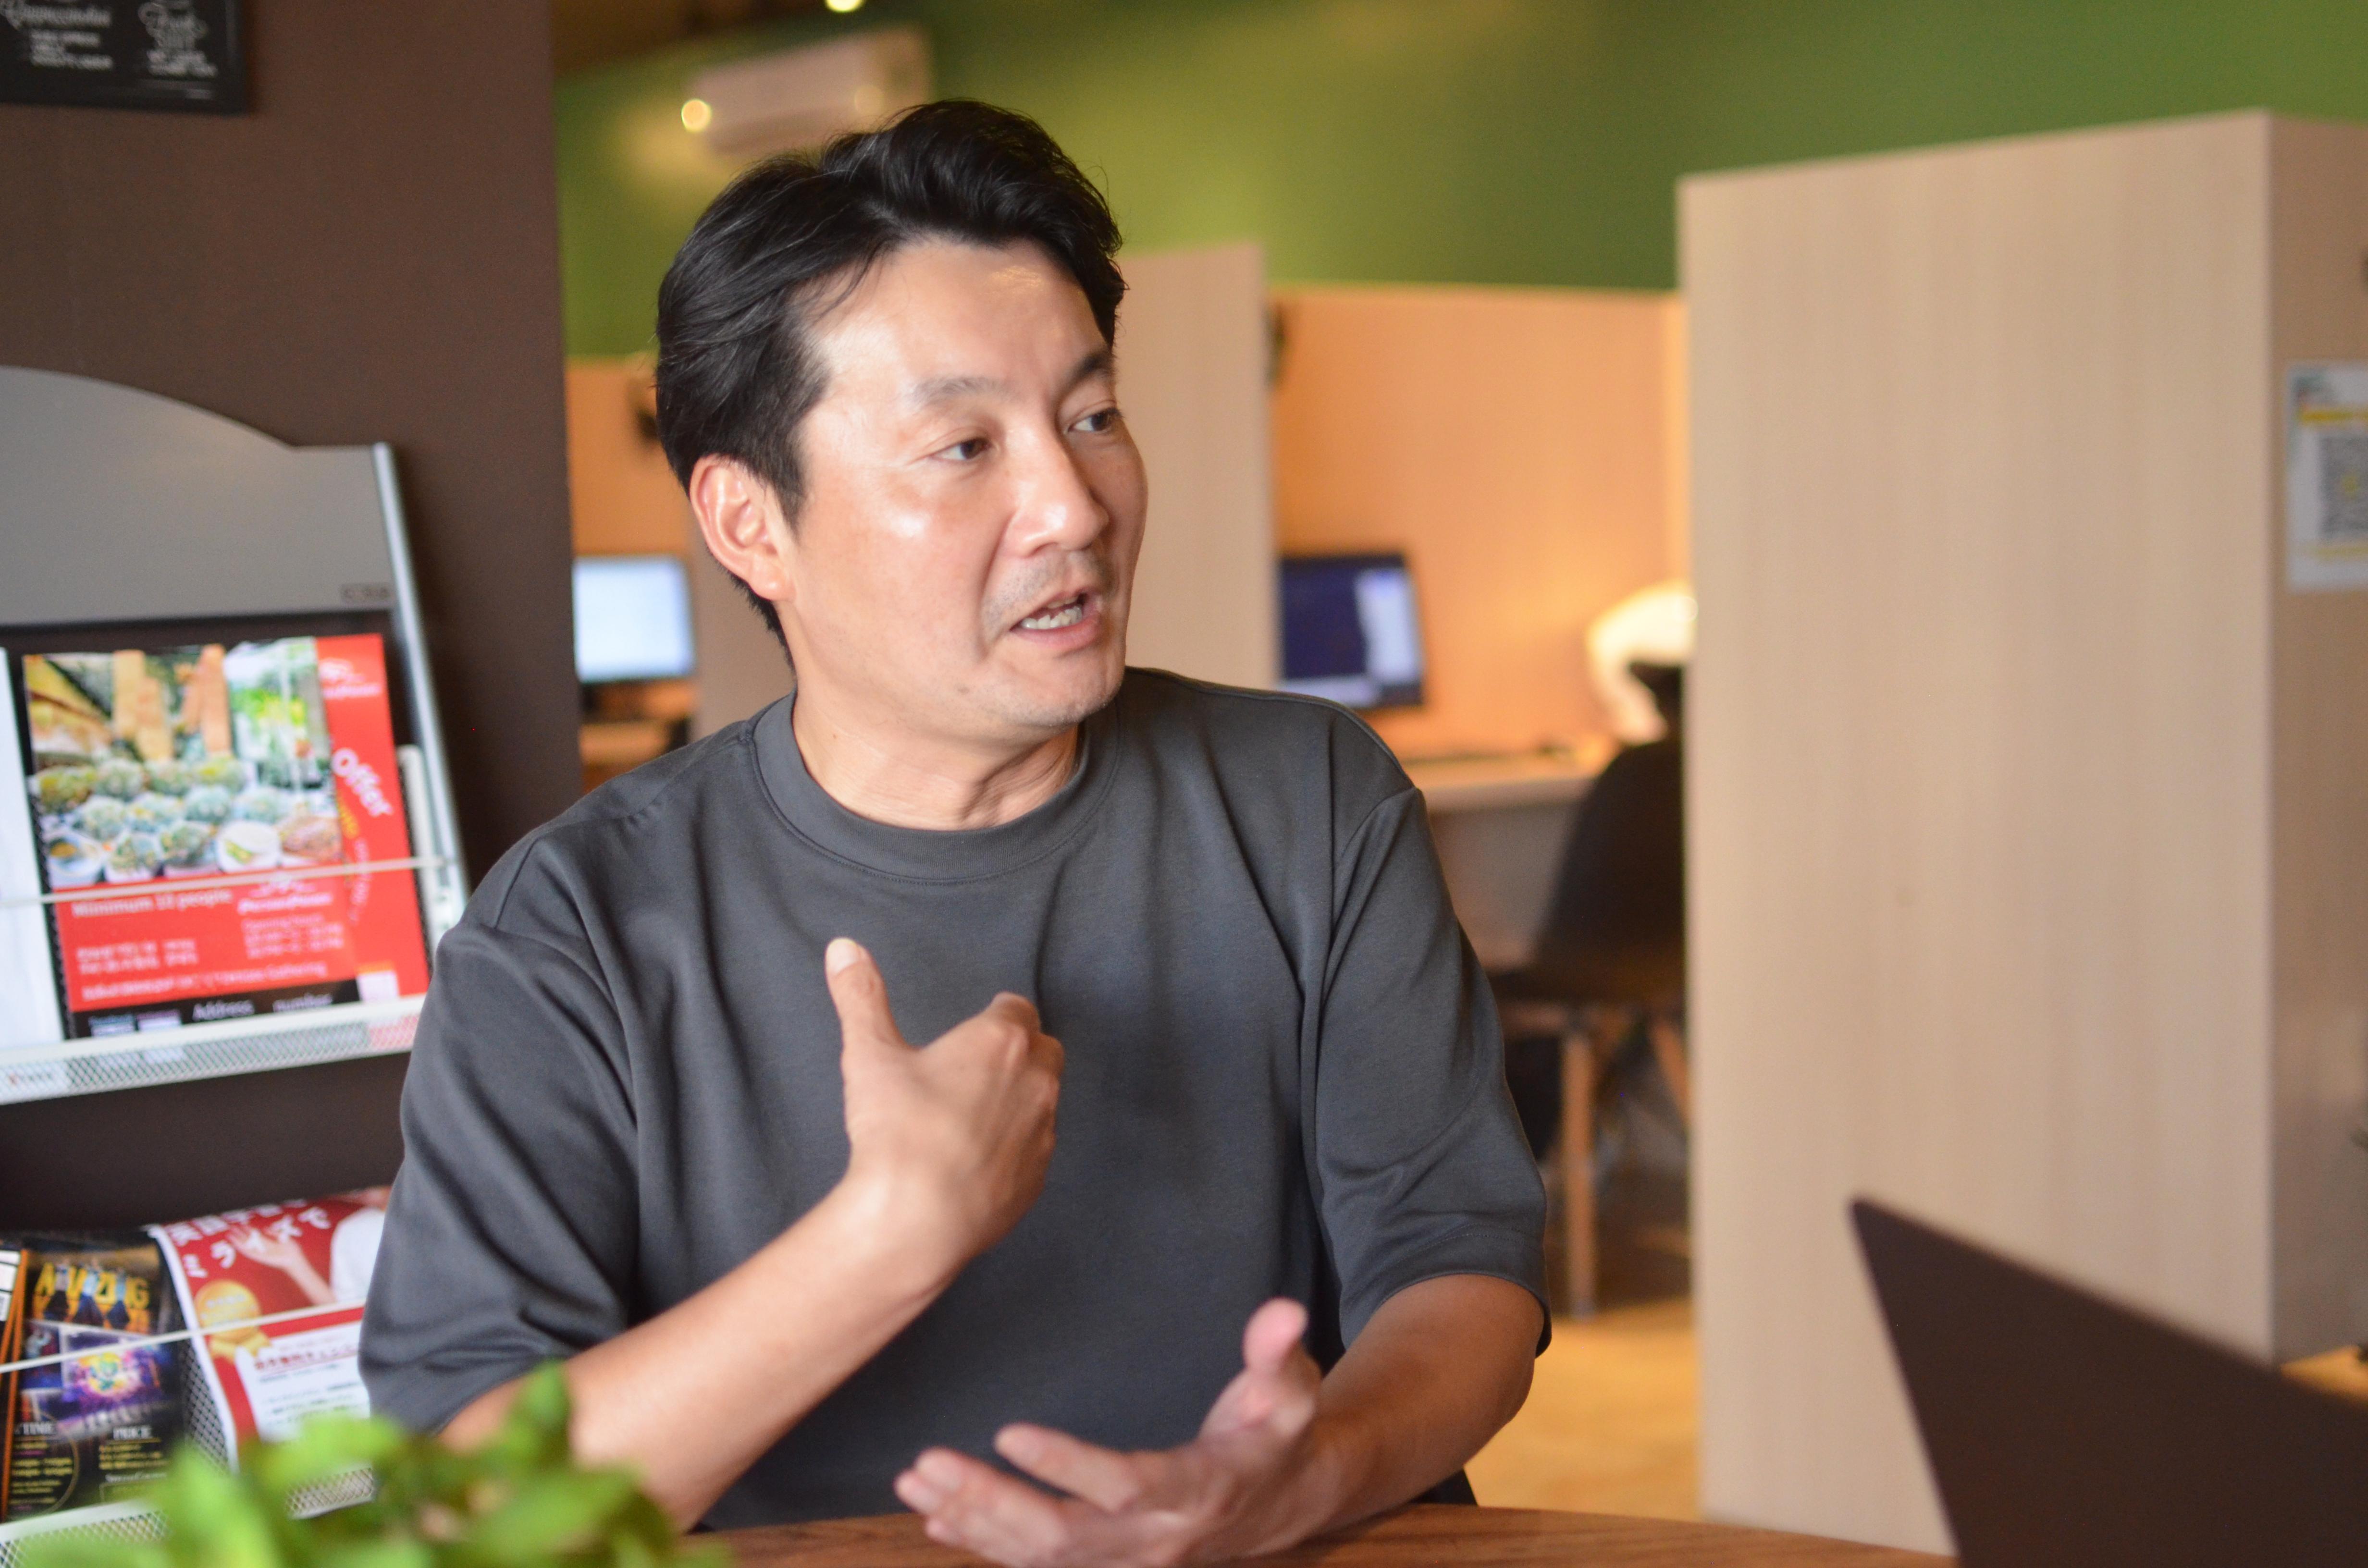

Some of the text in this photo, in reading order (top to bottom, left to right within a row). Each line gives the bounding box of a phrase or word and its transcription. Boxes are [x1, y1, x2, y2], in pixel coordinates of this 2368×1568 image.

[332, 748, 393, 816] Offer
[194, 1001, 254, 1020] Address
[114, 1426, 151, 1439] PRICE
